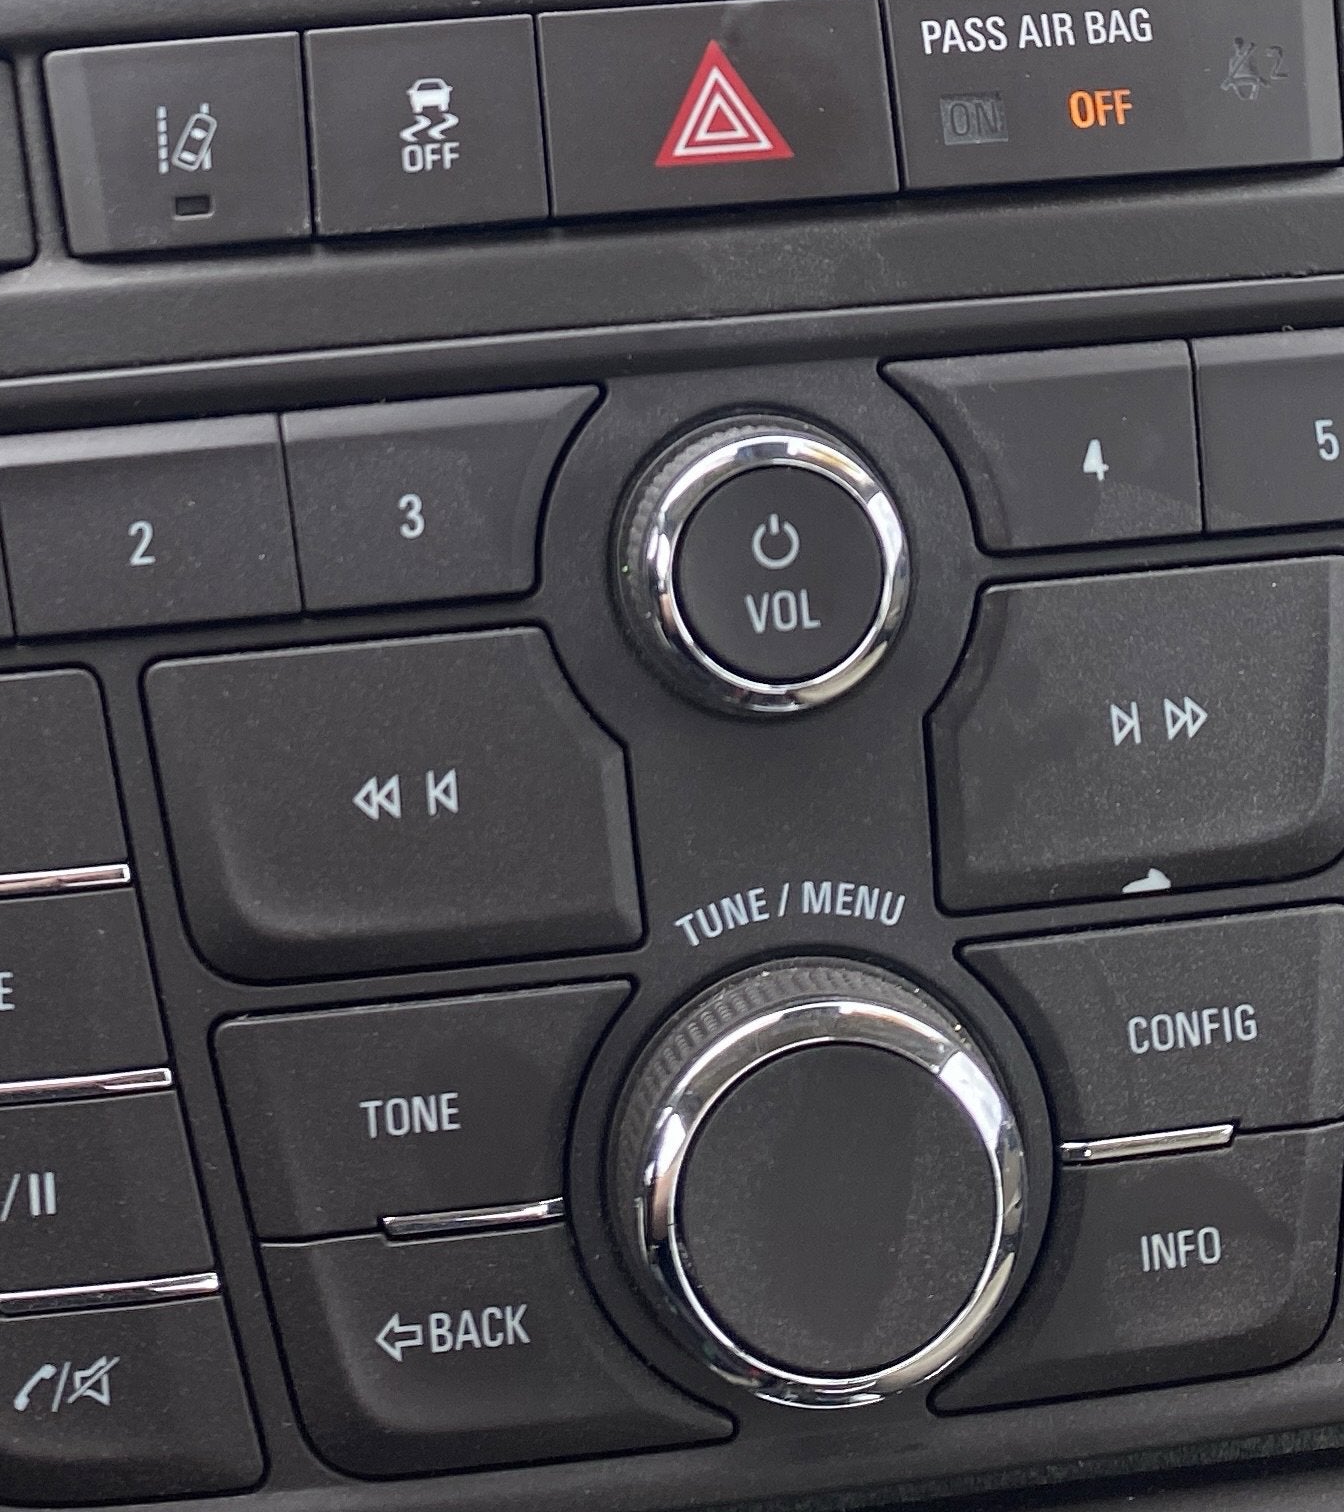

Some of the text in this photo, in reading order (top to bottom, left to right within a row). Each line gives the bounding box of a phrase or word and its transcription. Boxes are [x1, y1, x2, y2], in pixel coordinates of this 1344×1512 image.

[921, 7, 1153, 55] PASS AIR BAG
[949, 101, 999, 137] ON
[1069, 89, 1133, 129] OFF
[401, 140, 461, 174] OFF
[1083, 439, 1109, 481] 4
[1315, 419, 1340, 461] 5
[399, 493, 425, 538] 3
[130, 521, 156, 566] 2
[745, 589, 821, 633] VOL
[674, 881, 906, 946] TUNE / MENU
[1128, 1004, 1258, 1054] CONFIG
[359, 1092, 461, 1138] TONE
[1141, 1226, 1221, 1272] INFO
[429, 1304, 530, 1353] BACK
